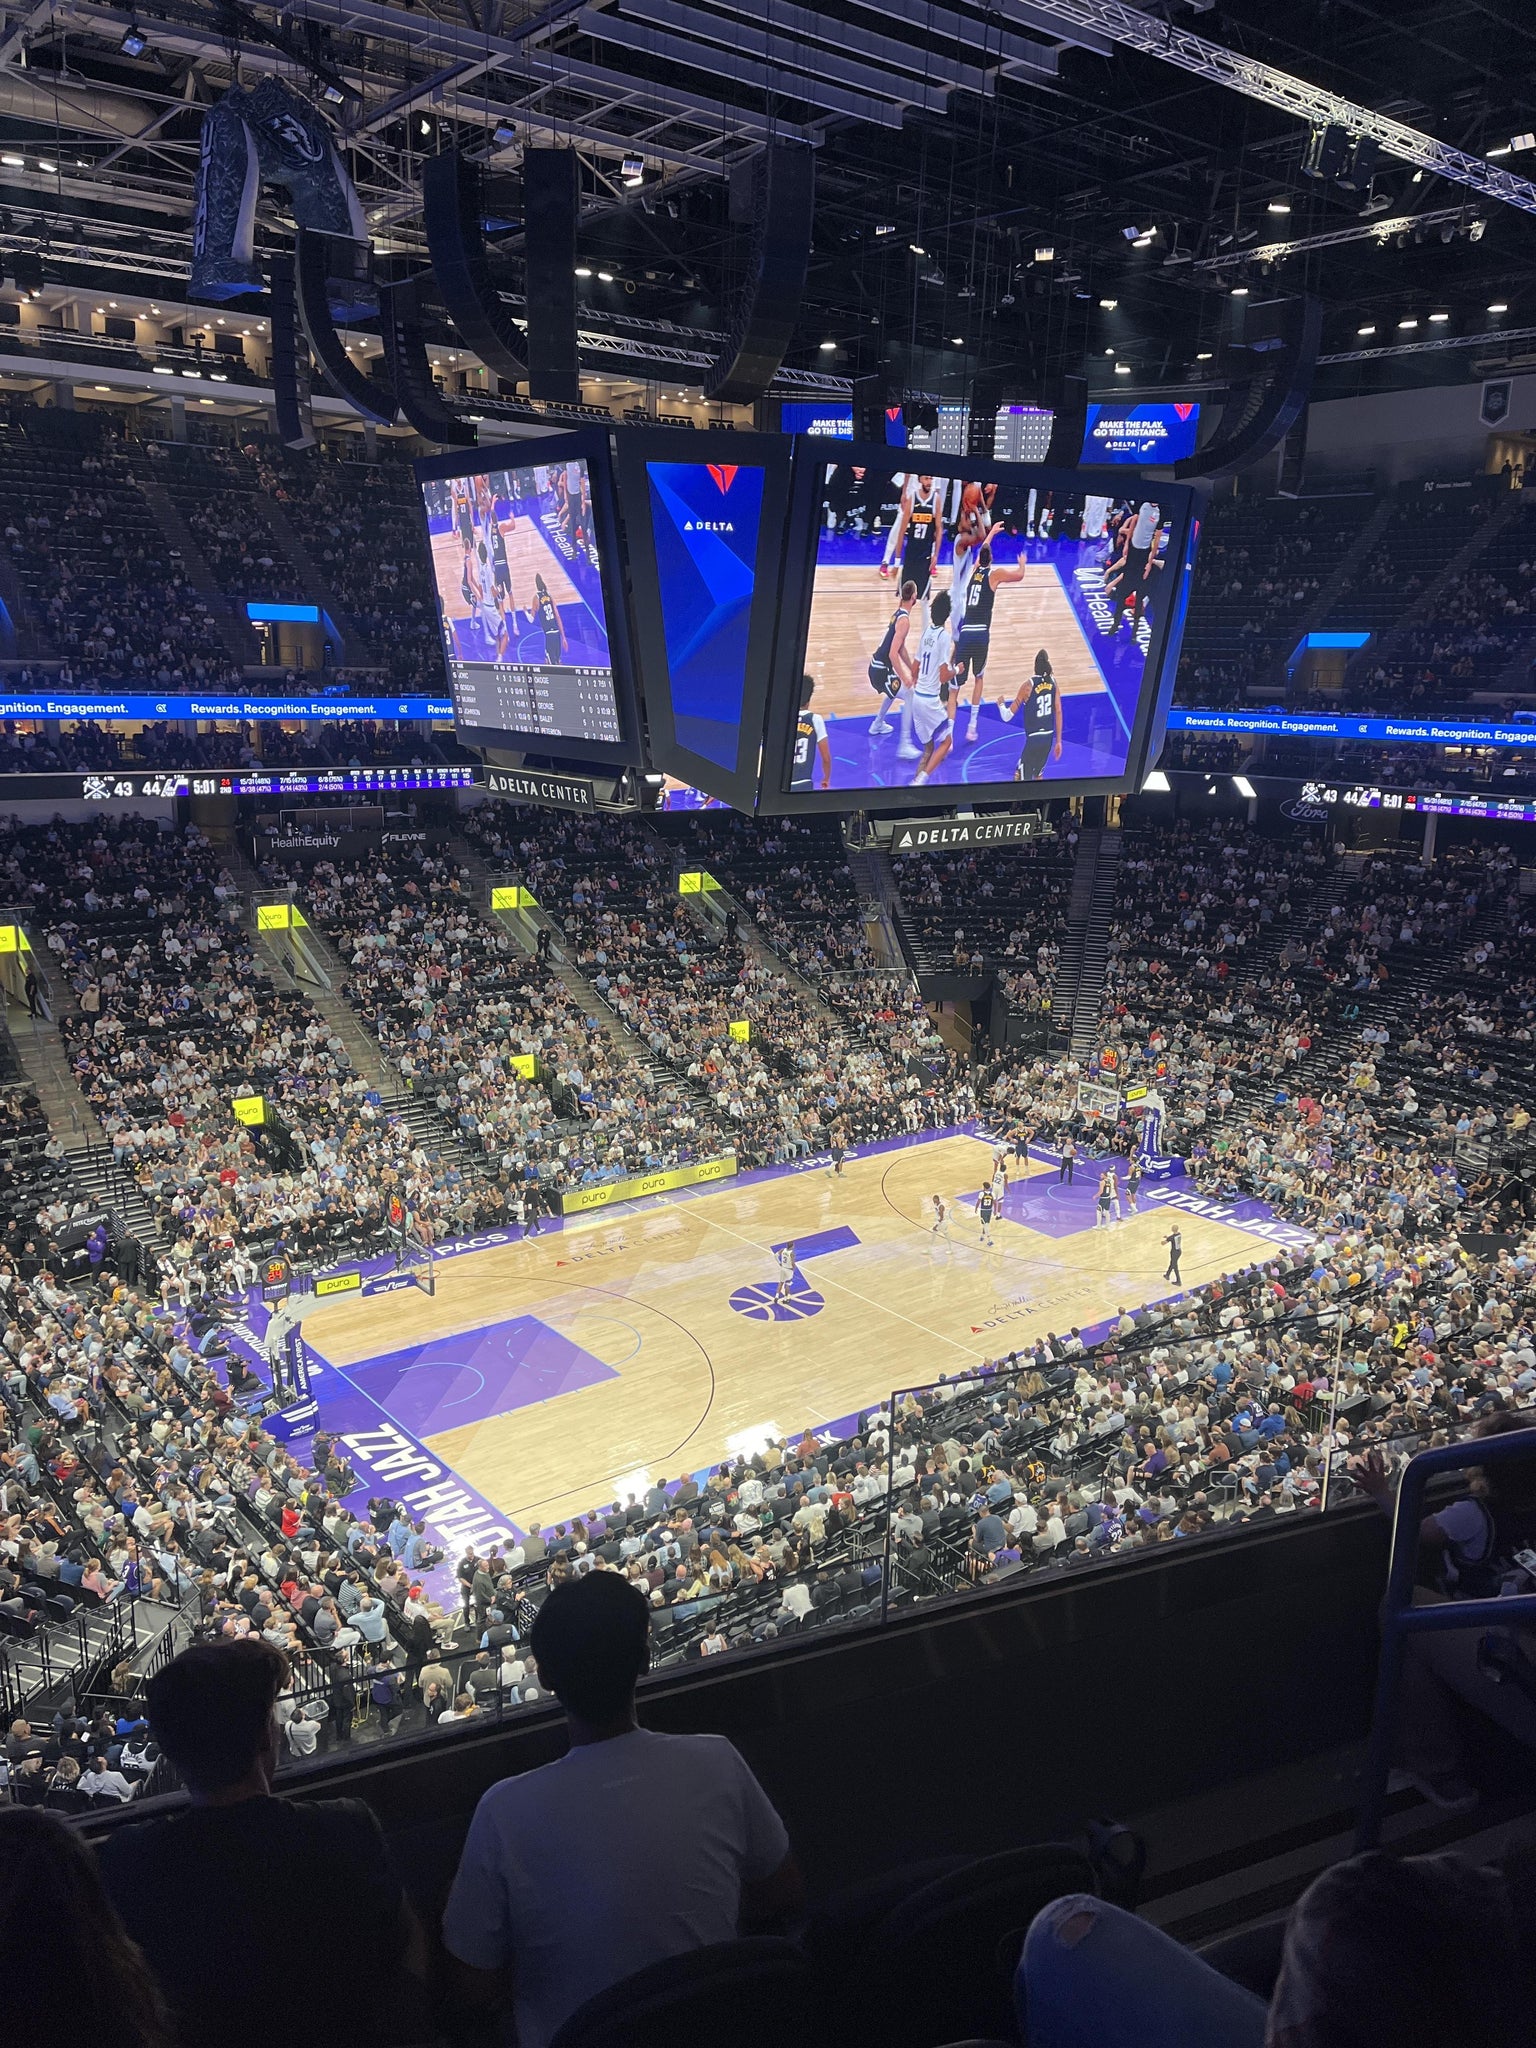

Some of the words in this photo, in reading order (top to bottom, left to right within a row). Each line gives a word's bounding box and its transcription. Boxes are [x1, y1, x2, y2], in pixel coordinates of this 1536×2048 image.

[1093, 428, 1108, 436] GO
[1108, 428, 1124, 436] THE
[1126, 428, 1168, 436] DISTANCE.
[1143, 421, 1163, 429] PLAY.
[696, 521, 734, 532] DELTA
[914, 523, 928, 538] 27
[968, 584, 982, 606] 15
[544, 604, 554, 620] 32
[922, 652, 931, 675] 11
[47, 702, 129, 716] Engagement.
[191, 704, 242, 714] Rewards.
[244, 704, 310, 716] Recognition.
[311, 704, 376, 716] Engagement.
[1036, 694, 1052, 718] 32
[1186, 716, 1226, 726] Rewards.
[1228, 718, 1280, 730] Recognition.
[1282, 720, 1338, 732] Engagement.
[1386, 726, 1429, 736] Rewards.
[1430, 728, 1492, 740] Recognition.
[114, 782, 132, 796] 43
[142, 781, 160, 796] 44
[193, 779, 215, 794] 5:01
[499, 776, 538, 796] DELTA
[541, 782, 588, 804] CENTER
[1323, 790, 1337, 802] 43
[1344, 791, 1358, 804] 44
[1383, 794, 1402, 808] 5:01
[390, 833, 427, 841] FILEVINE
[917, 827, 970, 845] DELTA
[975, 822, 1031, 840] CENTER
[271, 836, 339, 849] HealthEquity
[265, 912, 282, 921] pura
[237, 1106, 258, 1117] pura
[582, 1192, 606, 1205] pura
[642, 1178, 666, 1190] pura
[698, 1165, 721, 1177] pura
[994, 1176, 1001, 1184] 22
[1146, 1187, 1235, 1219] UTAH
[1226, 1218, 1316, 1248] JAZZ
[434, 1233, 508, 1256] PACS
[572, 1245, 629, 1262] DELTA
[327, 1278, 350, 1290] pura
[984, 1308, 1037, 1328] DELTA
[1038, 1287, 1095, 1309] CENTER
[294, 1338, 303, 1358] FIRST
[296, 1357, 308, 1390] AMERICA
[340, 1422, 442, 1482] JAZZ
[402, 1480, 514, 1558] UTAH
